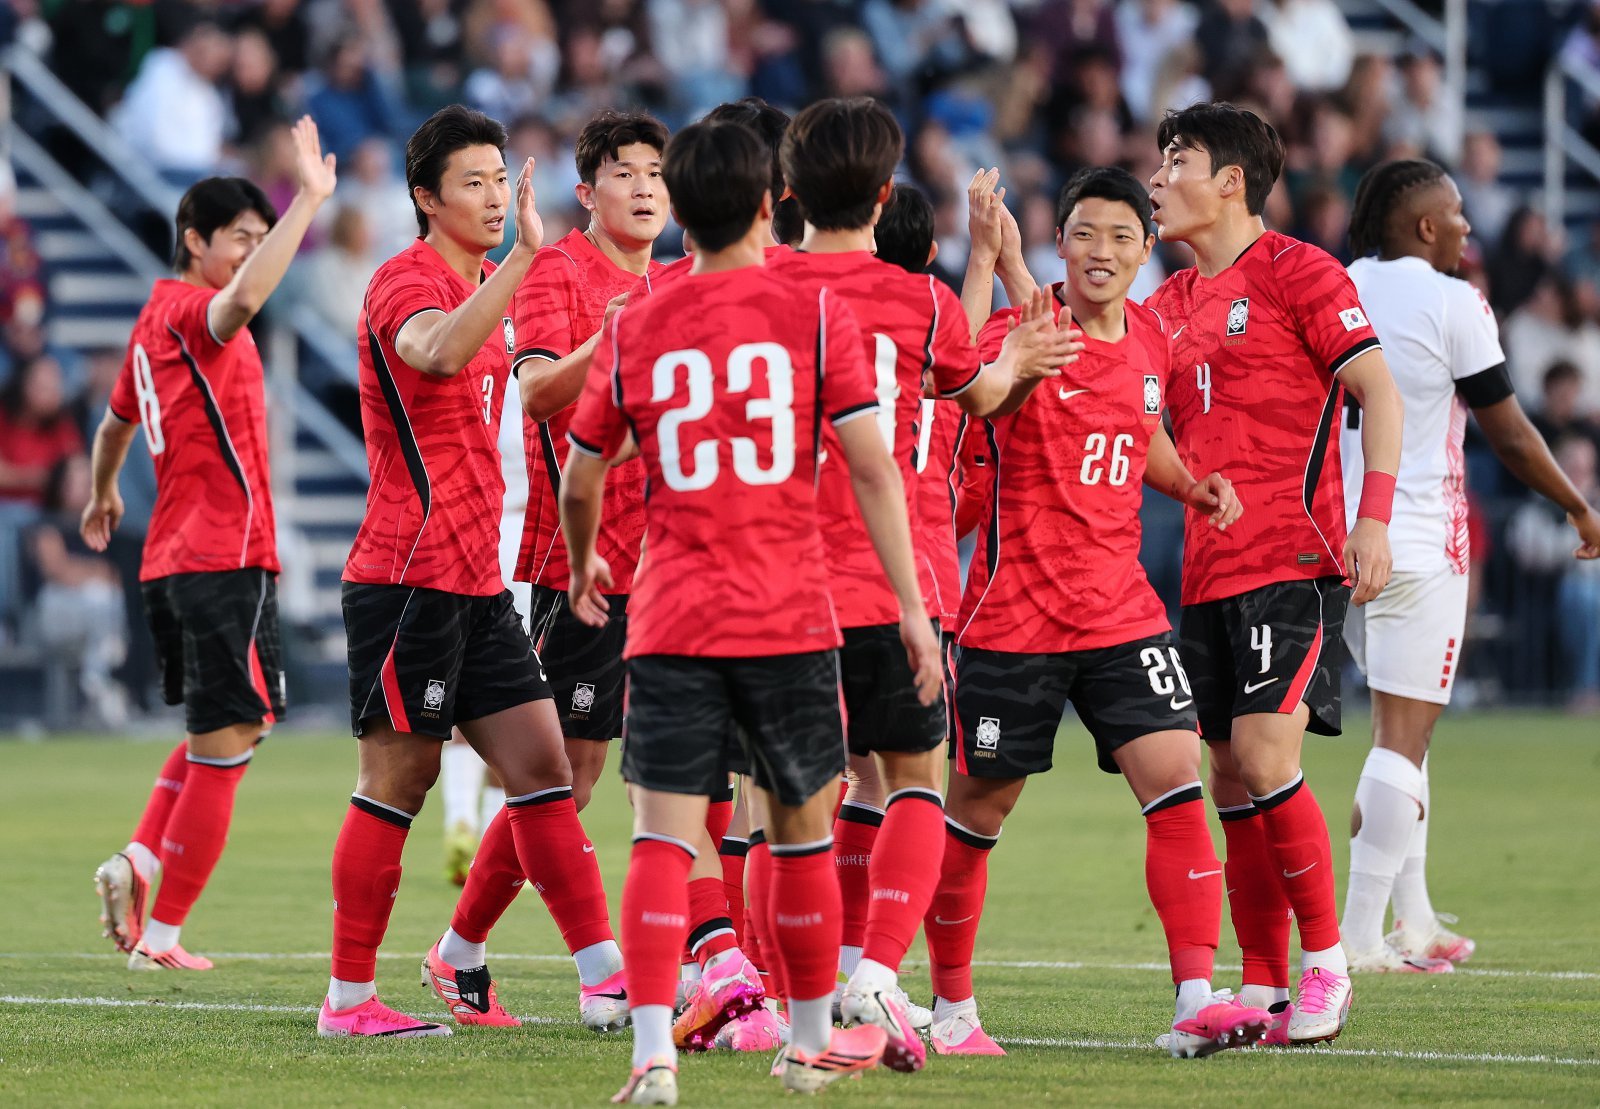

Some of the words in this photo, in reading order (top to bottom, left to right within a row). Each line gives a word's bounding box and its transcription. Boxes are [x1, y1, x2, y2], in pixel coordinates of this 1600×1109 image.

[133, 343, 165, 455] 8
[481, 374, 494, 425] 3
[1196, 362, 1211, 414] 4
[651, 341, 796, 492] 23
[1080, 433, 1134, 486] 26
[1250, 624, 1273, 674] 4
